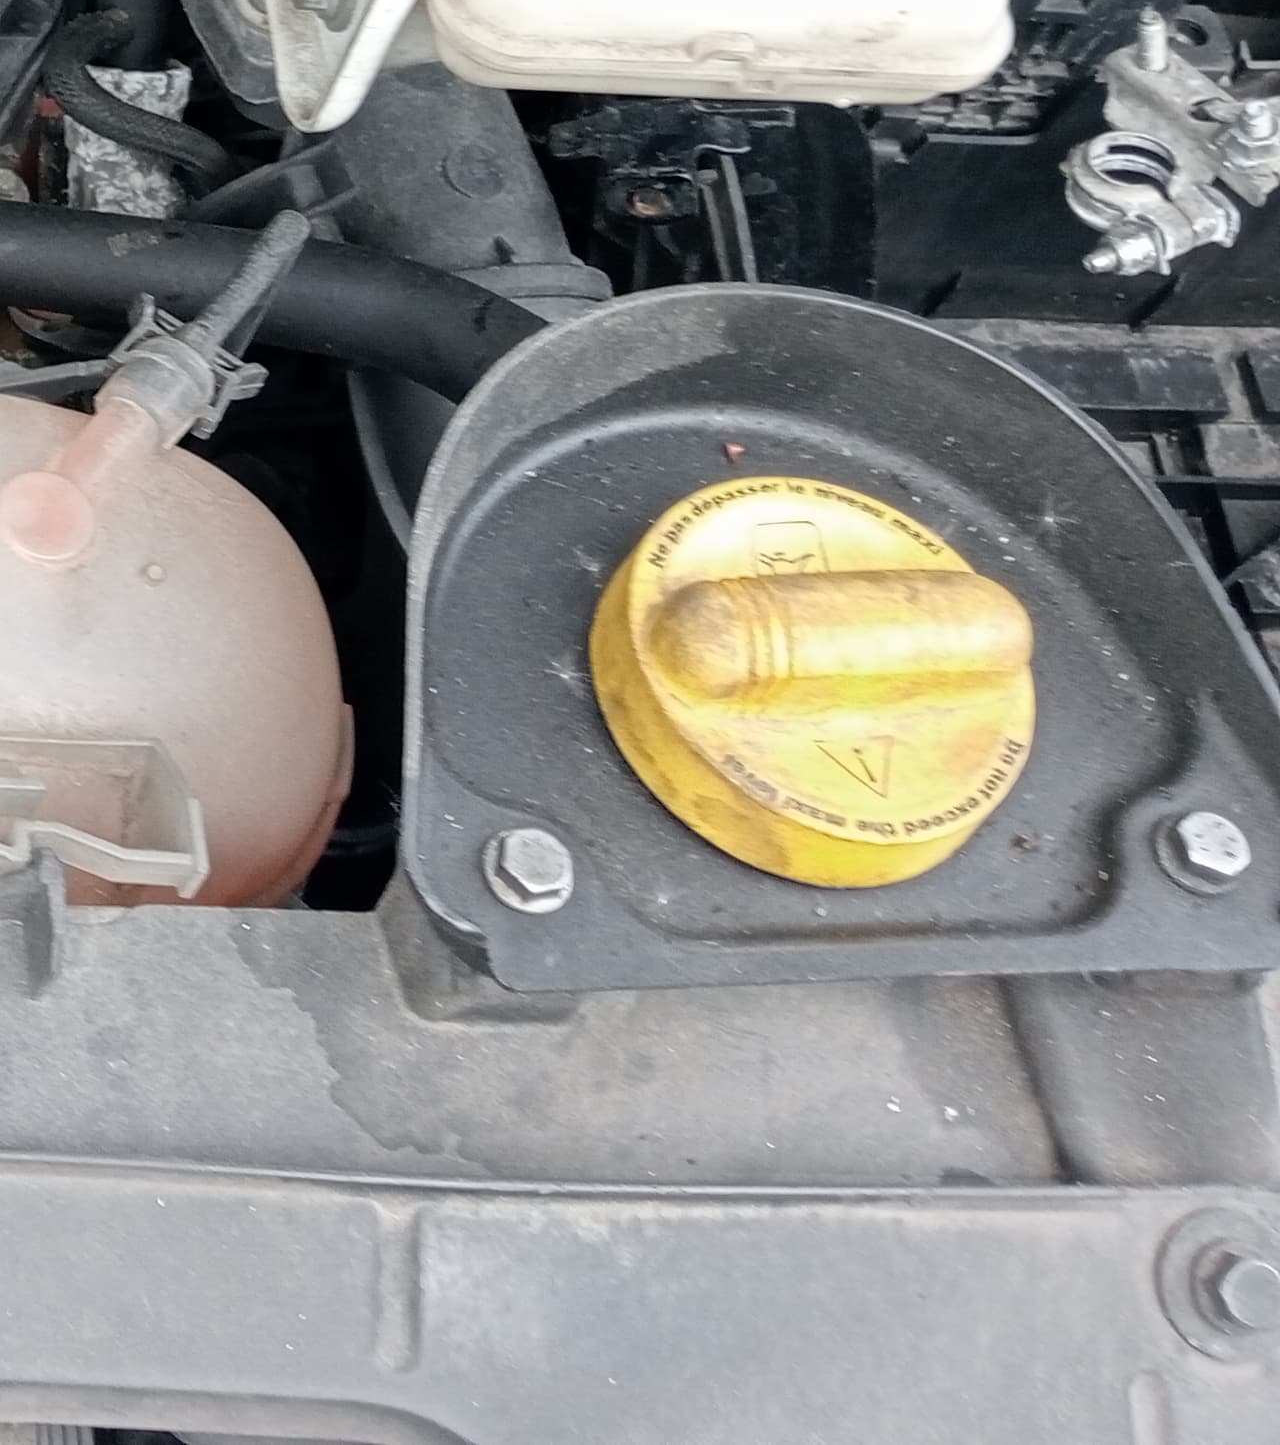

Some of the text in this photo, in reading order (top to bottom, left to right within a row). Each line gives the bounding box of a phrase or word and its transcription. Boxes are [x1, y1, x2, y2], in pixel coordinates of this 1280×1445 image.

[647, 542, 671, 569] Ne
[663, 514, 692, 545] pas
[786, 477, 806, 494] le
[999, 736, 1027, 766] Do
[977, 767, 1008, 800] not
[856, 818, 898, 839] the
[902, 795, 980, 836] exceed
